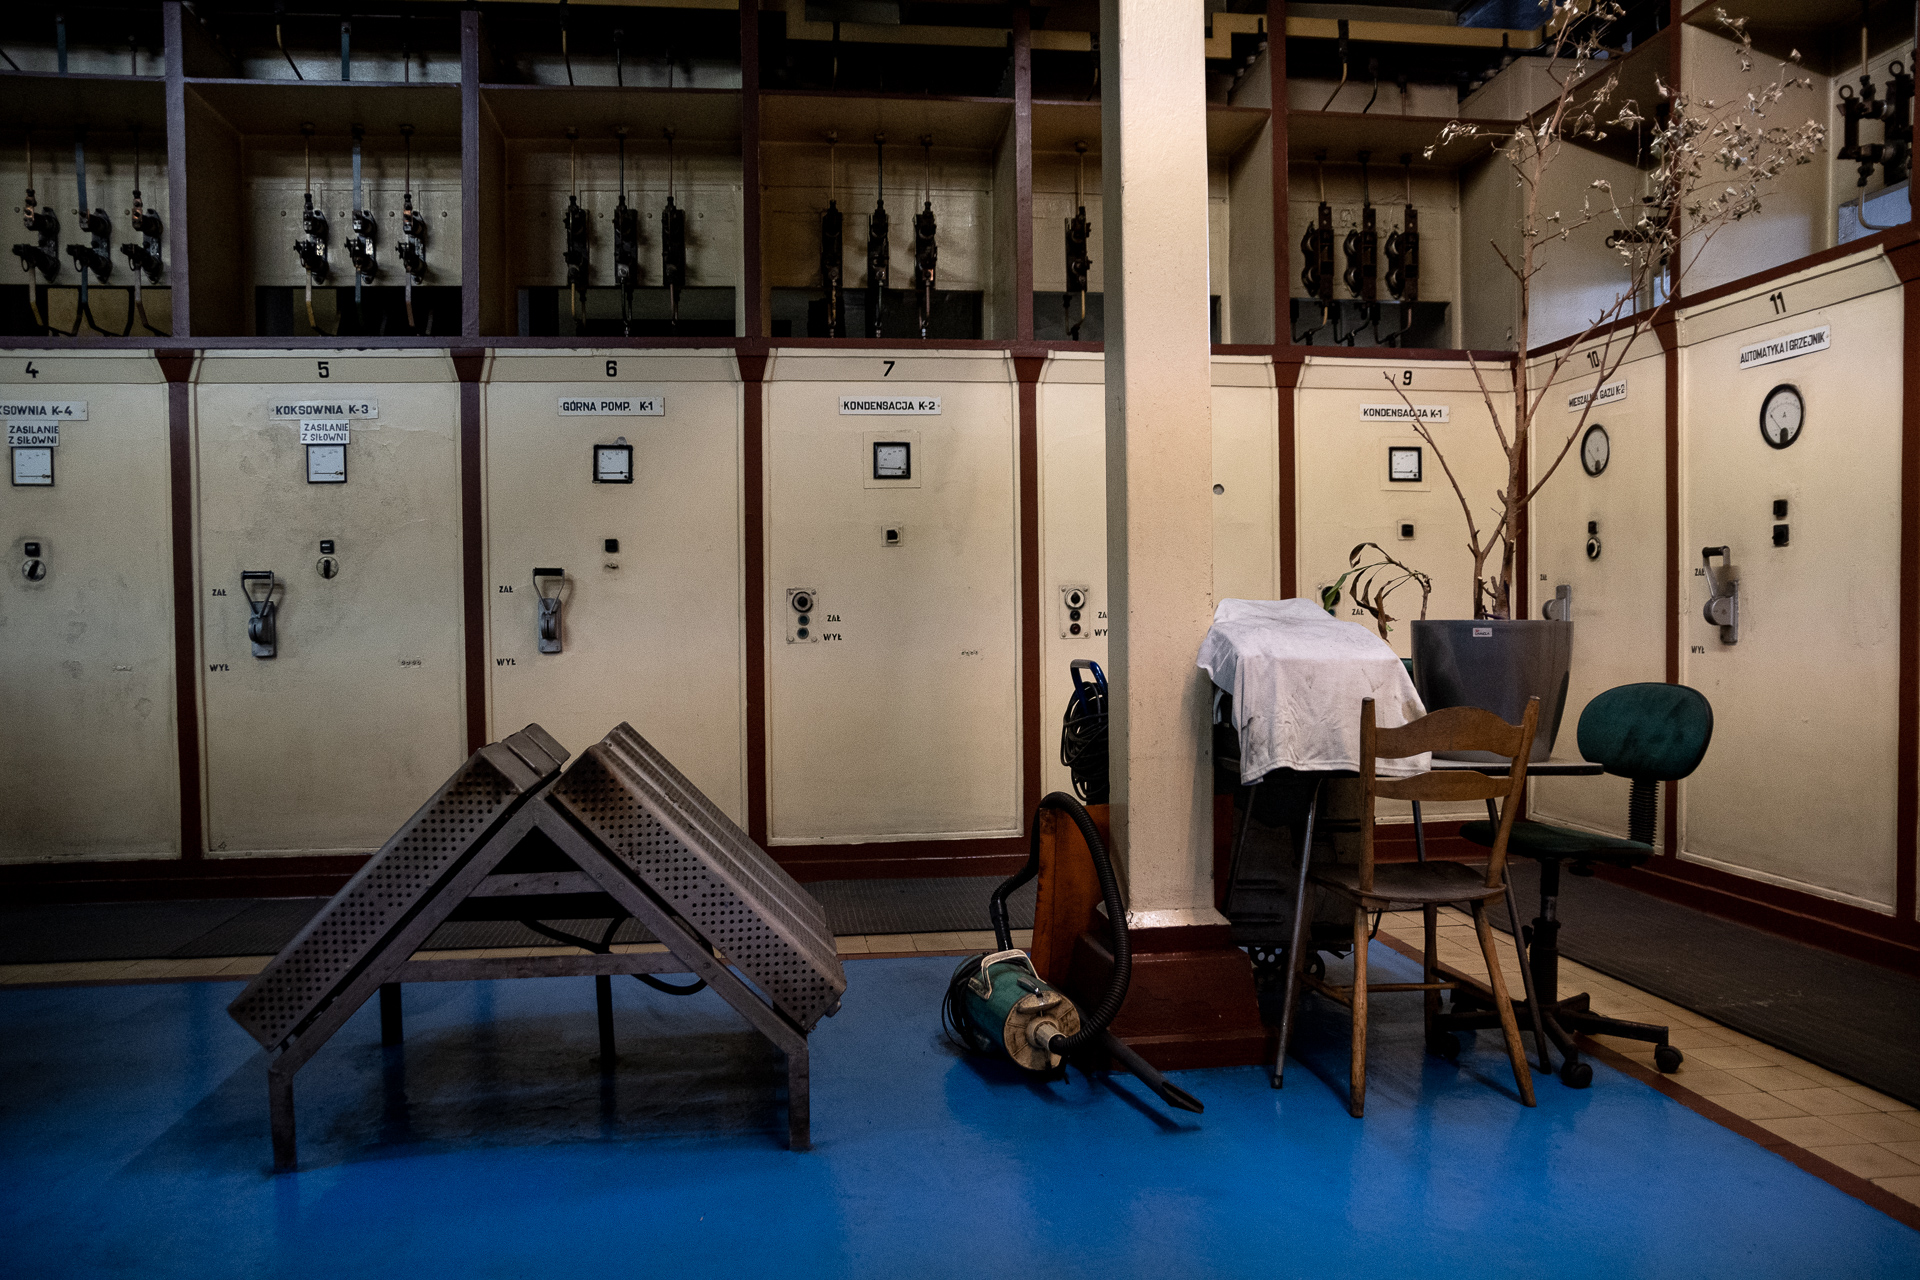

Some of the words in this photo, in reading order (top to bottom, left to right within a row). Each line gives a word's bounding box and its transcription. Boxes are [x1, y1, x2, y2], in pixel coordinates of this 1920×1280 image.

[1770, 291, 1786, 314] 11
[1740, 342, 1785, 364] AUTOMATYKA
[1785, 340, 1788, 352] I
[1789, 331, 1825, 351] GRZEJNIK
[1587, 350, 1600, 368] 10
[25, 361, 39, 378] 4
[317, 361, 329, 378] 5
[606, 360, 617, 377] 6
[883, 360, 895, 377] 7
[1403, 370, 1412, 385] 9
[1600, 386, 1615, 399] GAZU
[1616, 384, 1625, 395] K-2
[0, 405, 47, 415] SOWNIA
[51, 405, 73, 416] K-4
[275, 405, 343, 415] KOKSOWNIA
[348, 404, 369, 414] K-3
[562, 400, 597, 411] GÓRNA
[600, 401, 631, 411] POMP.
[640, 401, 653, 411] K-1
[843, 401, 915, 410] KONDENSACJA
[918, 401, 935, 410] K-2
[1363, 408, 1428, 418] KONDENSACJA
[1430, 409, 1442, 418] K-1
[9, 426, 59, 434] ZASILANIE
[304, 423, 348, 431] ZASILANIE
[8, 436, 14, 444] Z
[16, 436, 57, 444] SIŁOWNI
[310, 433, 347, 441] SIŁOWNI
[1695, 568, 1705, 576] ZAŁ
[1098, 611, 1107, 619] ZA
[823, 633, 842, 641] WYŁ
[1691, 645, 1705, 654] WYŁ
[496, 658, 516, 666] WYŁ
[209, 664, 229, 672] WYŁ
